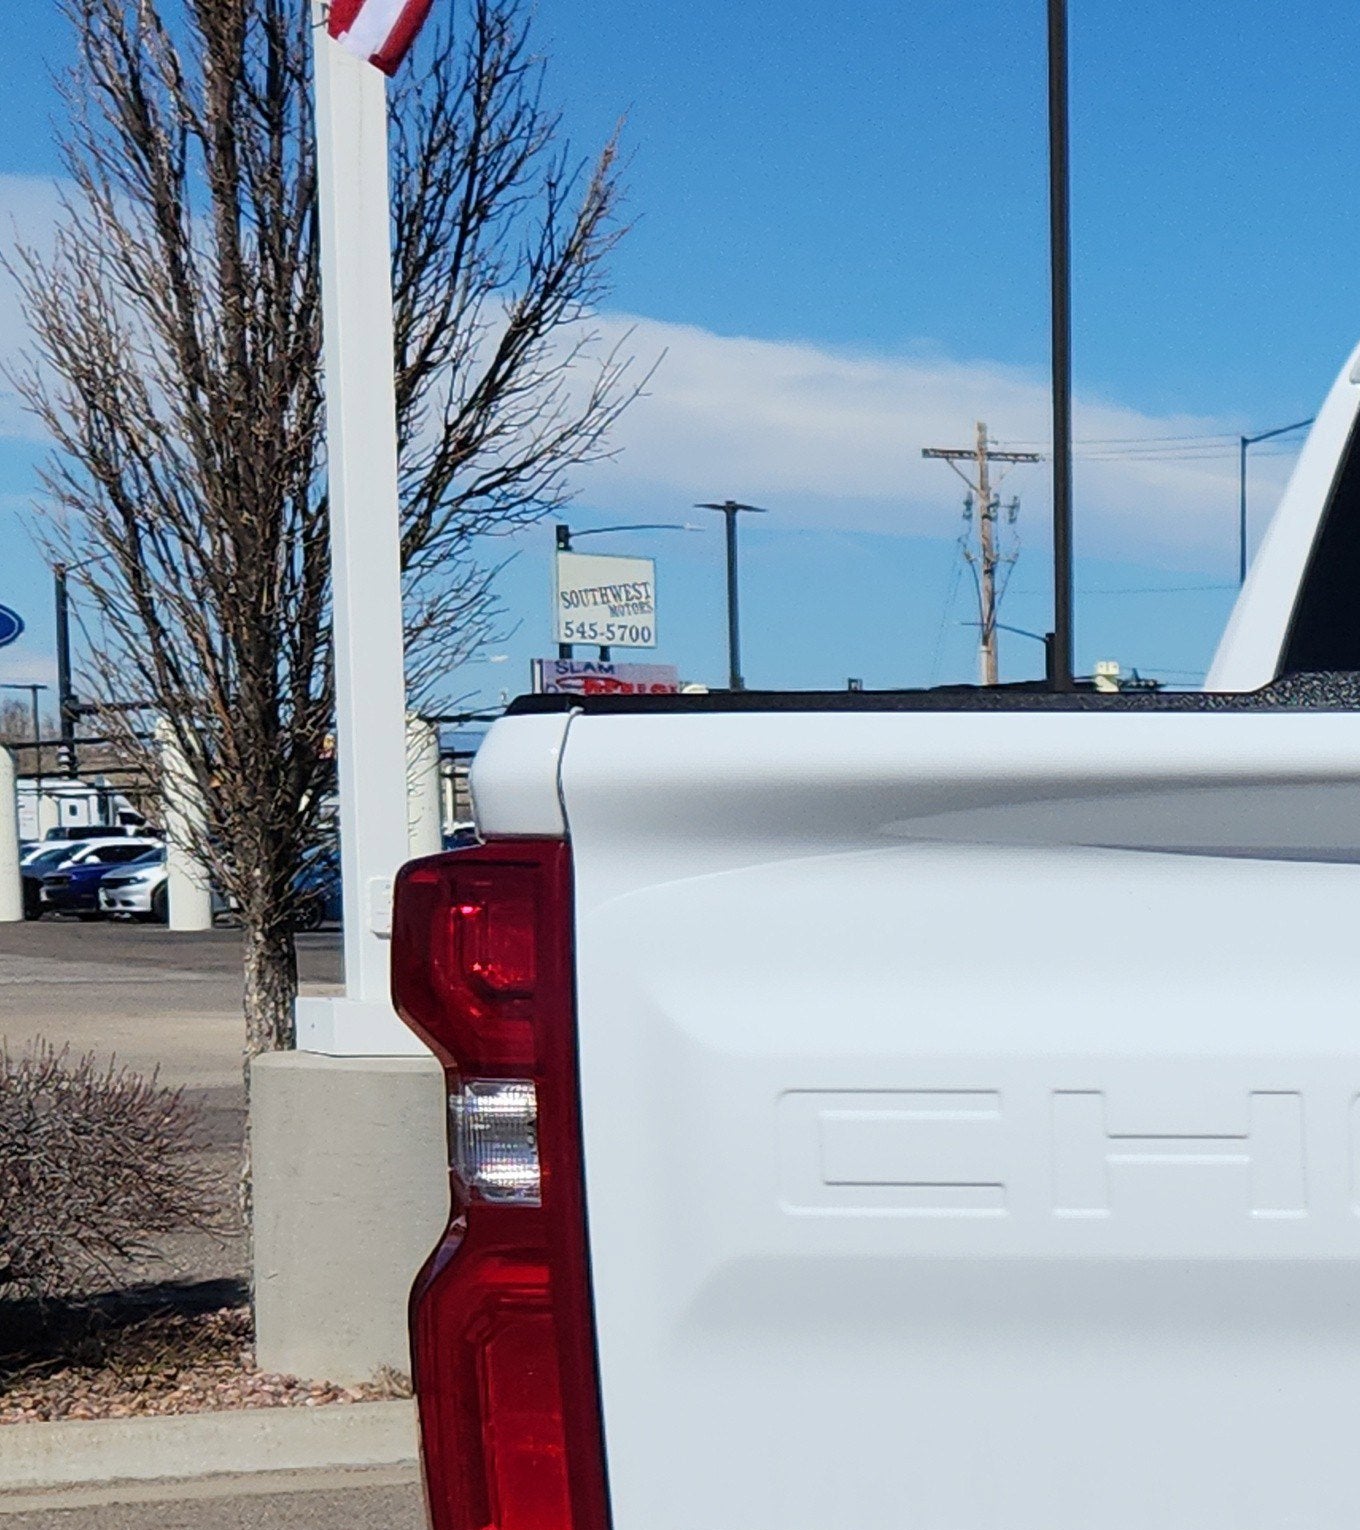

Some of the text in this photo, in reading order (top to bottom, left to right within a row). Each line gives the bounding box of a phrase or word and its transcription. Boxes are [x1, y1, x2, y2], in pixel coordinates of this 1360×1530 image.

[560, 582, 652, 609] SOUTHWEST
[608, 601, 654, 617] MOTORS
[564, 620, 652, 643] 545-5700
[555, 661, 615, 675] SLAM
